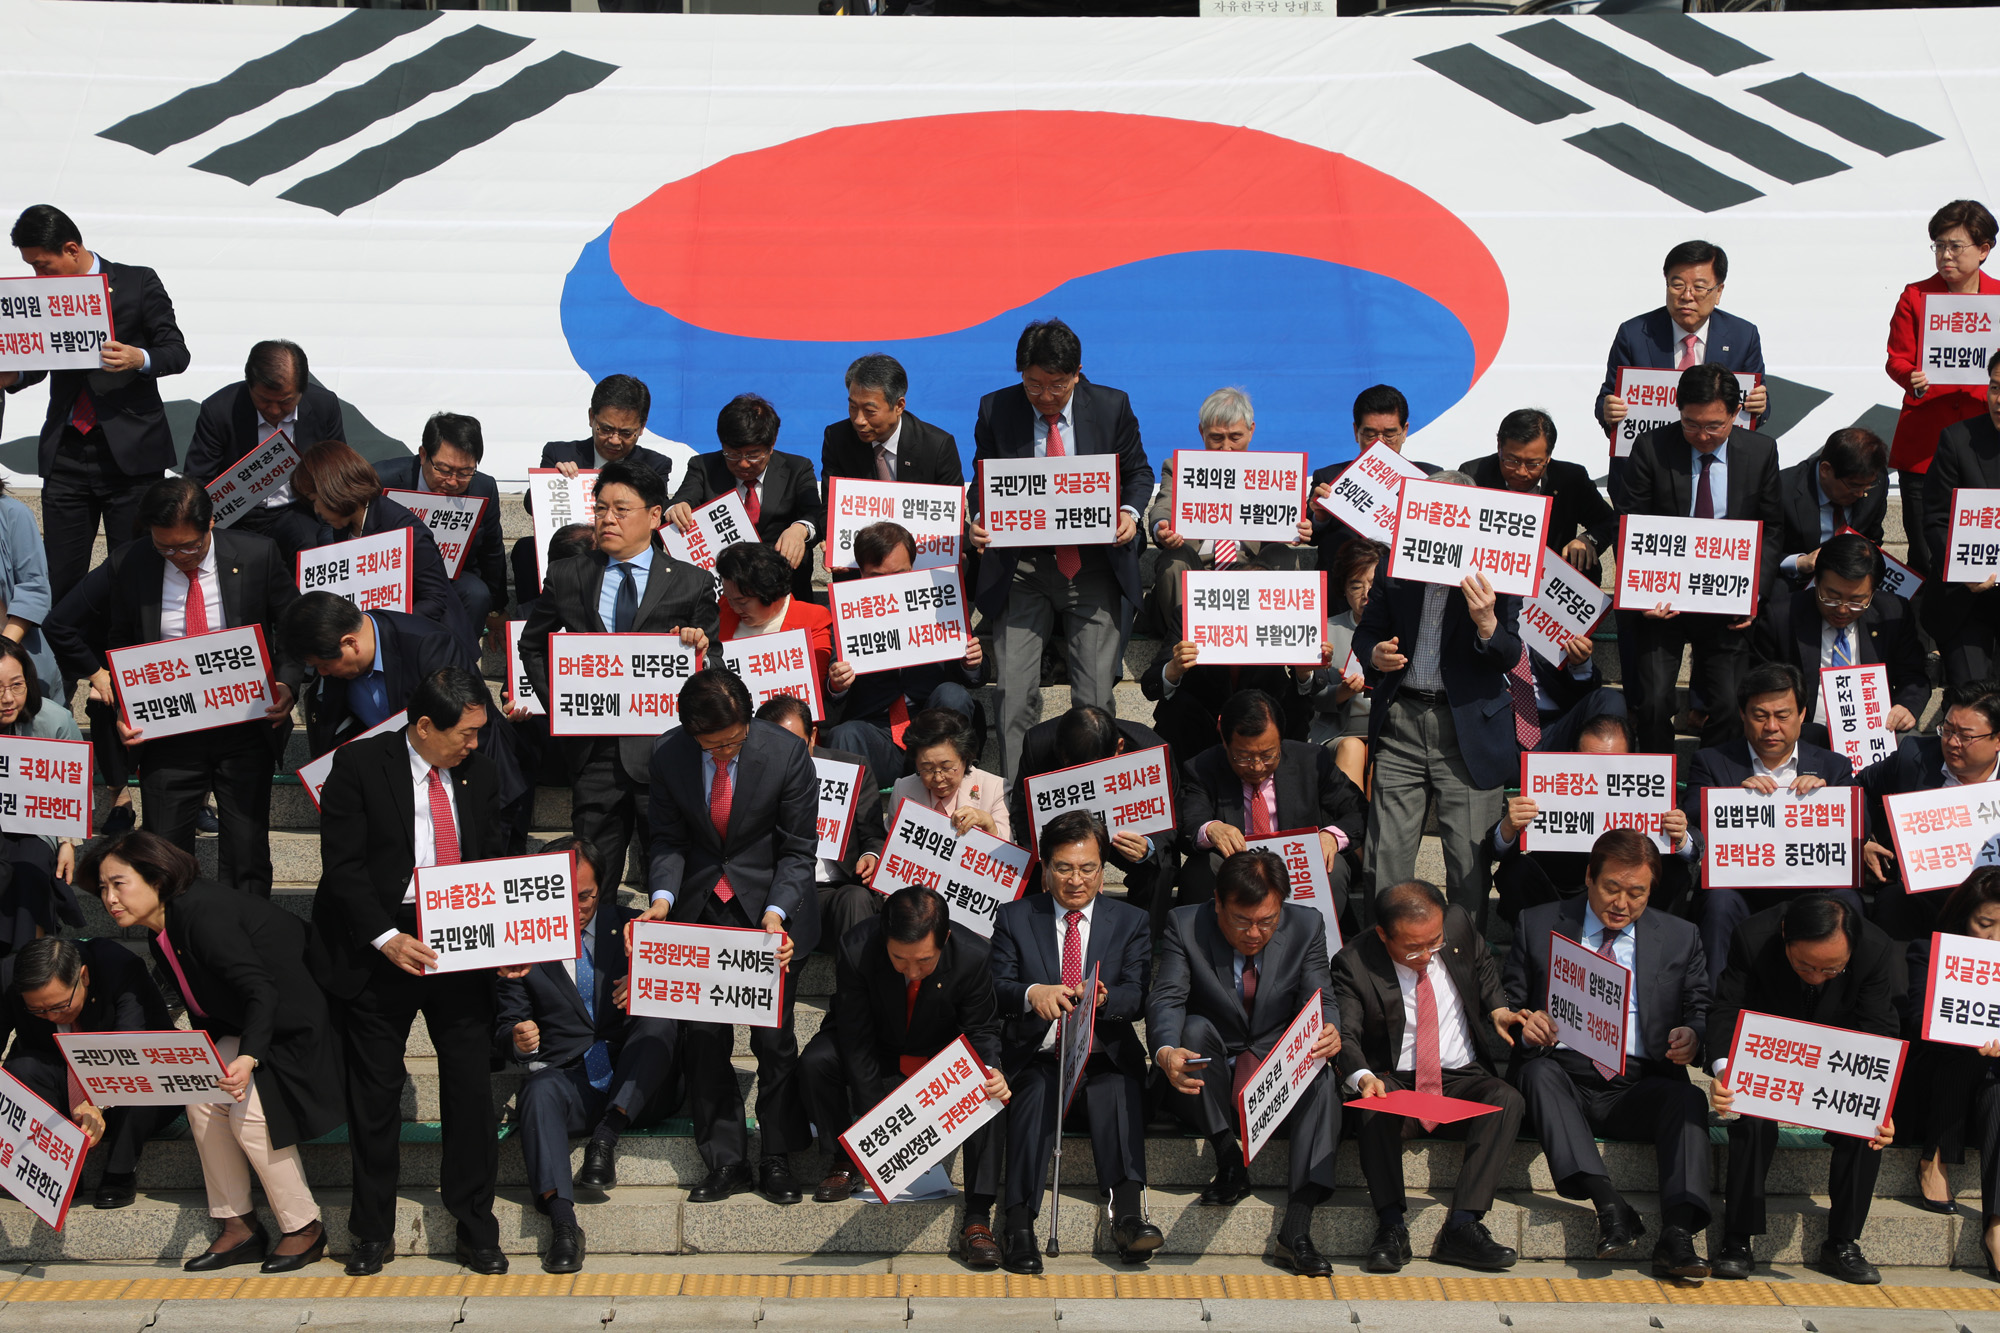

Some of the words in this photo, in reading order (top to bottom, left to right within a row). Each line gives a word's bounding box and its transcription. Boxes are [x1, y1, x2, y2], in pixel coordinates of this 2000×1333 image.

[1213, 1, 1280, 13] 자유한국당
[1285, 1, 1324, 13] 당대표
[0, 296, 41, 318] 회의원
[47, 294, 102, 317] 전원사찰
[1929, 312, 1992, 334] BH출장소
[1929, 347, 1986, 369] 국민앞에
[210, 480, 236, 503] 위에
[237, 442, 286, 482] 압박공작
[248, 456, 297, 494] 각성하라
[990, 474, 1047, 497] 국민기만
[1053, 470, 1111, 494] 댓글공작
[1182, 466, 1236, 490] 국회의원
[1242, 468, 1298, 492] 전원사찰
[1358, 454, 1401, 490] 선관위에
[840, 495, 895, 518] 선관위에
[902, 499, 956, 522] 압박공작
[1334, 477, 1374, 513] 청와대는
[428, 509, 474, 531] 압박공작
[708, 504, 741, 545] 입법부
[990, 508, 1047, 532] 민주당을
[1054, 506, 1111, 529] 규탄한다
[1181, 500, 1233, 525] 독재정치
[1239, 503, 1297, 526] 부활인가?
[1406, 501, 1471, 529] BH출장소
[1478, 508, 1537, 538] 민주당은
[438, 542, 462, 564] 하라
[912, 533, 955, 556] 성하라
[1402, 537, 1463, 568] 국민앞에
[1469, 547, 1532, 578] 사죄하라
[1631, 533, 1687, 557] 국회의원
[1694, 536, 1751, 561] 전원사찰
[304, 558, 350, 589] 헌정유린
[356, 547, 403, 577] 국회사찰
[1626, 570, 1681, 594] 독재정치
[1687, 573, 1749, 597] 부활인가?
[360, 583, 402, 611] 규탄한다
[841, 593, 899, 620] BH출장소
[904, 584, 957, 612] 민주당은
[1193, 587, 1251, 611] 국회의원
[1257, 587, 1316, 611] 전원사찰
[1545, 577, 1596, 625] 민주당은
[847, 628, 901, 657] 국민앞에
[908, 619, 961, 648] 사죄하라
[1193, 623, 1249, 648] 독재정치
[1255, 624, 1317, 648] 부활인가?
[122, 658, 191, 687] BH출장소
[195, 645, 257, 676] 민주당은
[558, 654, 624, 678] BH출장소
[631, 654, 689, 679] 민주당은
[748, 647, 805, 676] 국회사찰
[132, 692, 197, 723] 국민앞에
[203, 680, 265, 710] 사죄하라
[559, 693, 620, 717] 국민앞에
[1835, 675, 1857, 732] 여론조작
[1860, 672, 1883, 730] 일벌백계
[1869, 737, 1887, 763] 으로
[19, 757, 83, 784] 국회사찰
[1533, 772, 1599, 796] BH출장소
[1606, 774, 1666, 798] 민주당은
[818, 778, 849, 806] 조작
[1036, 780, 1096, 812] 헌정유린
[1103, 764, 1161, 795] 국회사찰
[24, 795, 82, 822] 규탄한다
[1112, 796, 1165, 827] 규탄한다
[1533, 811, 1594, 835] 국민앞에
[1713, 804, 1775, 829] 입법부에
[1783, 803, 1846, 829] 공갈협박
[1899, 805, 1973, 835] 국정원댓글
[816, 817, 841, 844] 백계
[899, 819, 957, 862] 국회의원
[960, 845, 1018, 888] 전원사찰
[1714, 843, 1776, 868] 권력남용
[1784, 842, 1847, 868] 중단하라
[1908, 842, 1974, 873] 댓글공작
[1283, 841, 1316, 900] 선관위에
[426, 882, 496, 910] BH출장소
[503, 874, 565, 904] 민주당은
[886, 854, 942, 890] 독재정치
[944, 880, 1000, 921] 부활인가
[430, 923, 495, 953] 국민앞에
[504, 915, 568, 945] 사죄하라
[638, 941, 710, 969] 국정원댓글
[716, 949, 775, 974] 수사하듯
[637, 978, 701, 1004] 댓글공작
[709, 984, 773, 1011] 수사하라
[1553, 954, 1586, 992] 선관위에
[1589, 972, 1622, 1010] 압박공작
[1551, 993, 1583, 1031] 청와대는
[1587, 1011, 1619, 1051] 각성하라
[1940, 997, 2000, 1028] 특검으로
[72, 1048, 140, 1066] 국민기만
[142, 1047, 210, 1065] 댓글공작
[1248, 1059, 1282, 1115] 헌정유린
[1285, 1010, 1319, 1064] 국회사찰
[1744, 1033, 1821, 1070] 국정원댓글
[1827, 1048, 1891, 1083] 수사하듯
[86, 1076, 154, 1094] 민주당을
[1735, 1070, 1804, 1106] 댓글공작
[1811, 1087, 1881, 1120] 수사하라
[858, 1103, 917, 1158] 헌정유린
[915, 1056, 974, 1109] 국회사찰
[1251, 1081, 1290, 1143] 문재인정권
[0, 1092, 26, 1132] 기만
[27, 1117, 75, 1171] 댓글공작
[876, 1125, 941, 1184] 문재인정권
[938, 1083, 992, 1134] 규탄한다
[15, 1154, 63, 1208] 규탄한다
